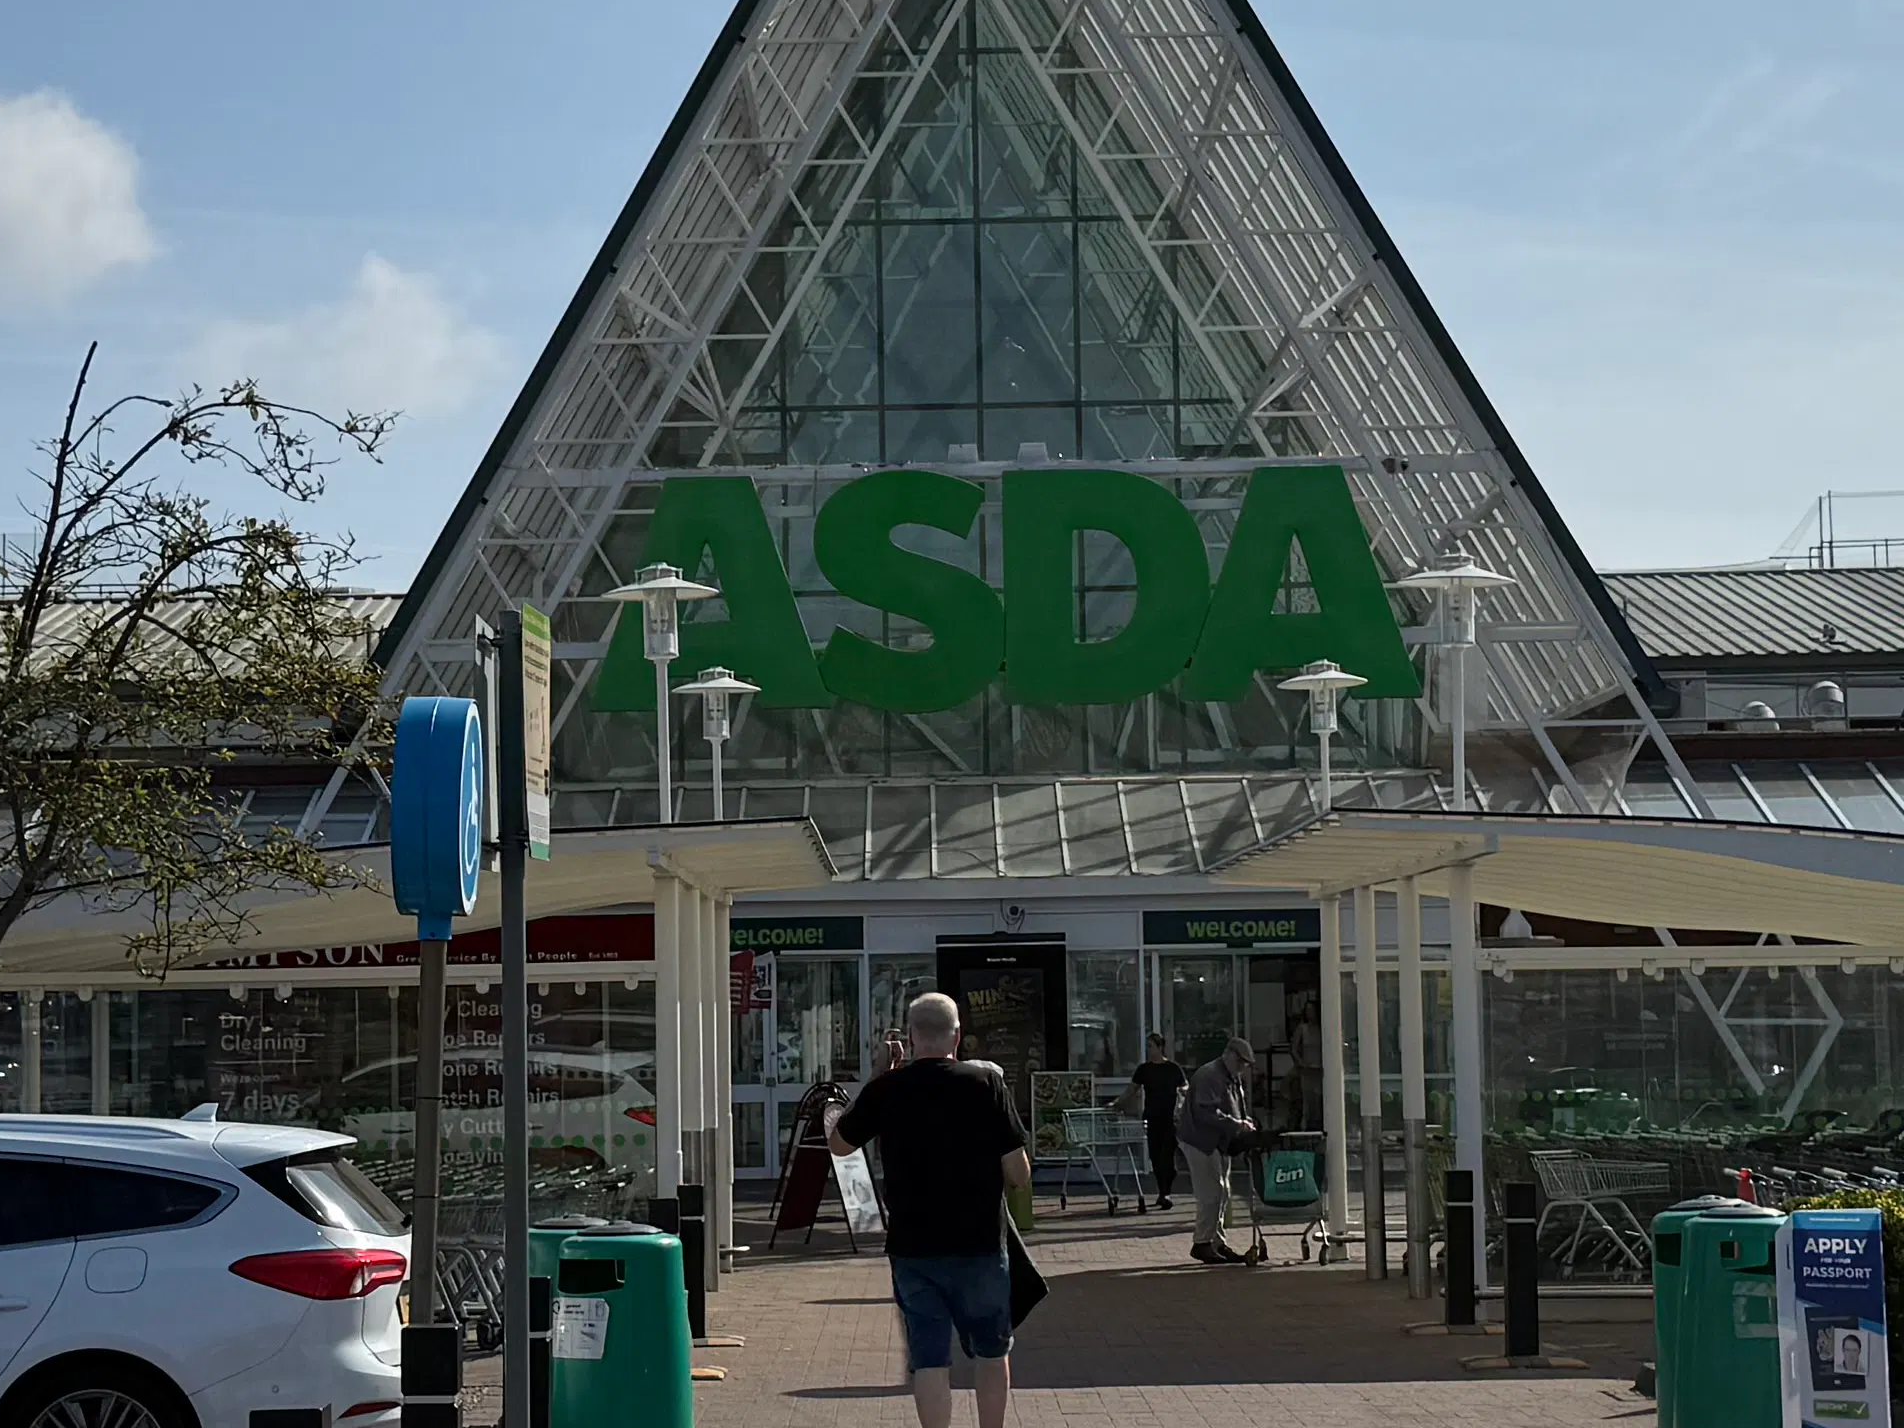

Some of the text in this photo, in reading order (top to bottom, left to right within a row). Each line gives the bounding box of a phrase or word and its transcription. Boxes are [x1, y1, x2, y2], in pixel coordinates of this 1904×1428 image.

[591, 464, 1423, 714] ASDA
[459, 1000, 542, 1019] Cleag
[221, 1033, 306, 1053] Cleaning
[473, 1029, 545, 1047] Rers
[221, 1089, 300, 1115] 7 days
[441, 1087, 560, 1107] atch Rirs
[1804, 1237, 1868, 1255] APPLY
[1803, 1266, 1873, 1280] PASSPORT
